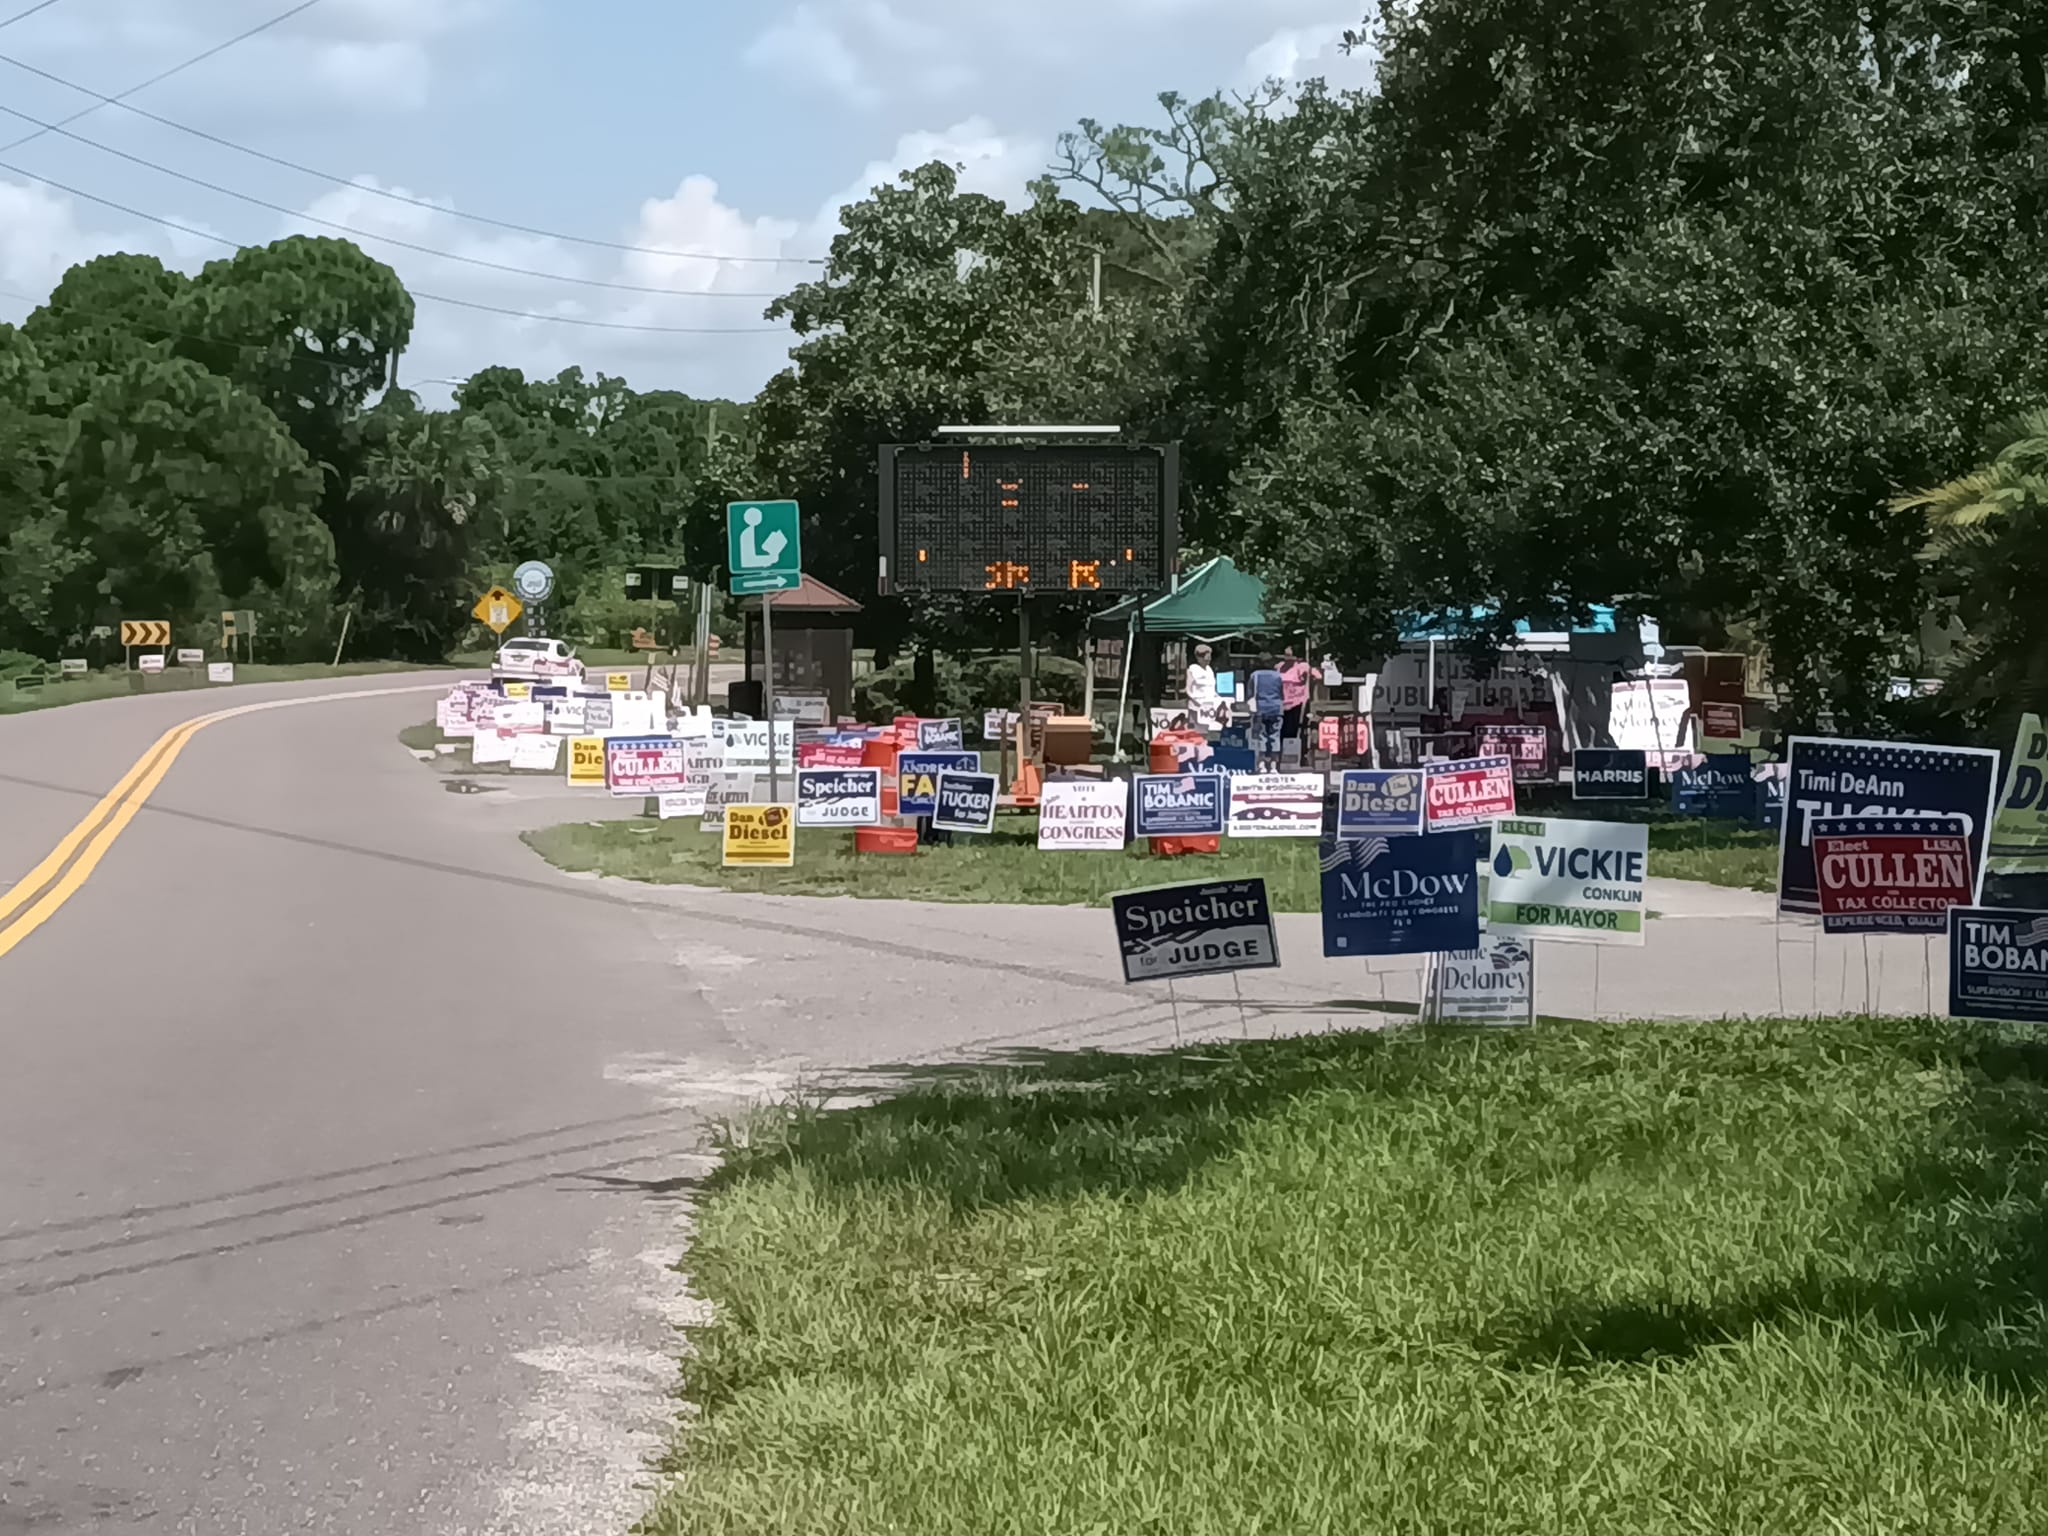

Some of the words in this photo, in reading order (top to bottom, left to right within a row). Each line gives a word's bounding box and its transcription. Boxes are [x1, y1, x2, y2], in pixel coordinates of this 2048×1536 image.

[743, 732, 790, 746] VICIE
[1346, 779, 1376, 792] Dan
[1577, 769, 1643, 783] HARRIS
[1681, 770, 1746, 786] McDow
[1798, 769, 1836, 793] Timi
[1840, 772, 1904, 798] DeAnn
[802, 777, 874, 798] Speicher
[1144, 783, 1171, 796] TIM
[1429, 777, 1510, 807] CULLEN
[942, 790, 990, 810] TUCKER
[1144, 792, 1214, 808] BOBANIC
[1345, 793, 1417, 812] Diesel
[729, 812, 754, 823] Dan
[821, 806, 870, 818] JUDGE
[729, 824, 788, 840] Diesel
[1040, 826, 1123, 840] CONGRESS
[1502, 821, 1542, 836] ELECT
[1534, 845, 1643, 883] VICKIE
[1822, 853, 1965, 889] CULLEN
[1340, 870, 1469, 900] McDow
[1836, 897, 1867, 910] TAX
[1126, 896, 1258, 935] Speicher
[1516, 904, 1550, 924] FOR
[1556, 907, 1618, 929] MAYOR
[1965, 922, 2010, 945] TIM
[1169, 939, 1259, 965] JUDGE
[1444, 965, 1525, 994] Delaney
